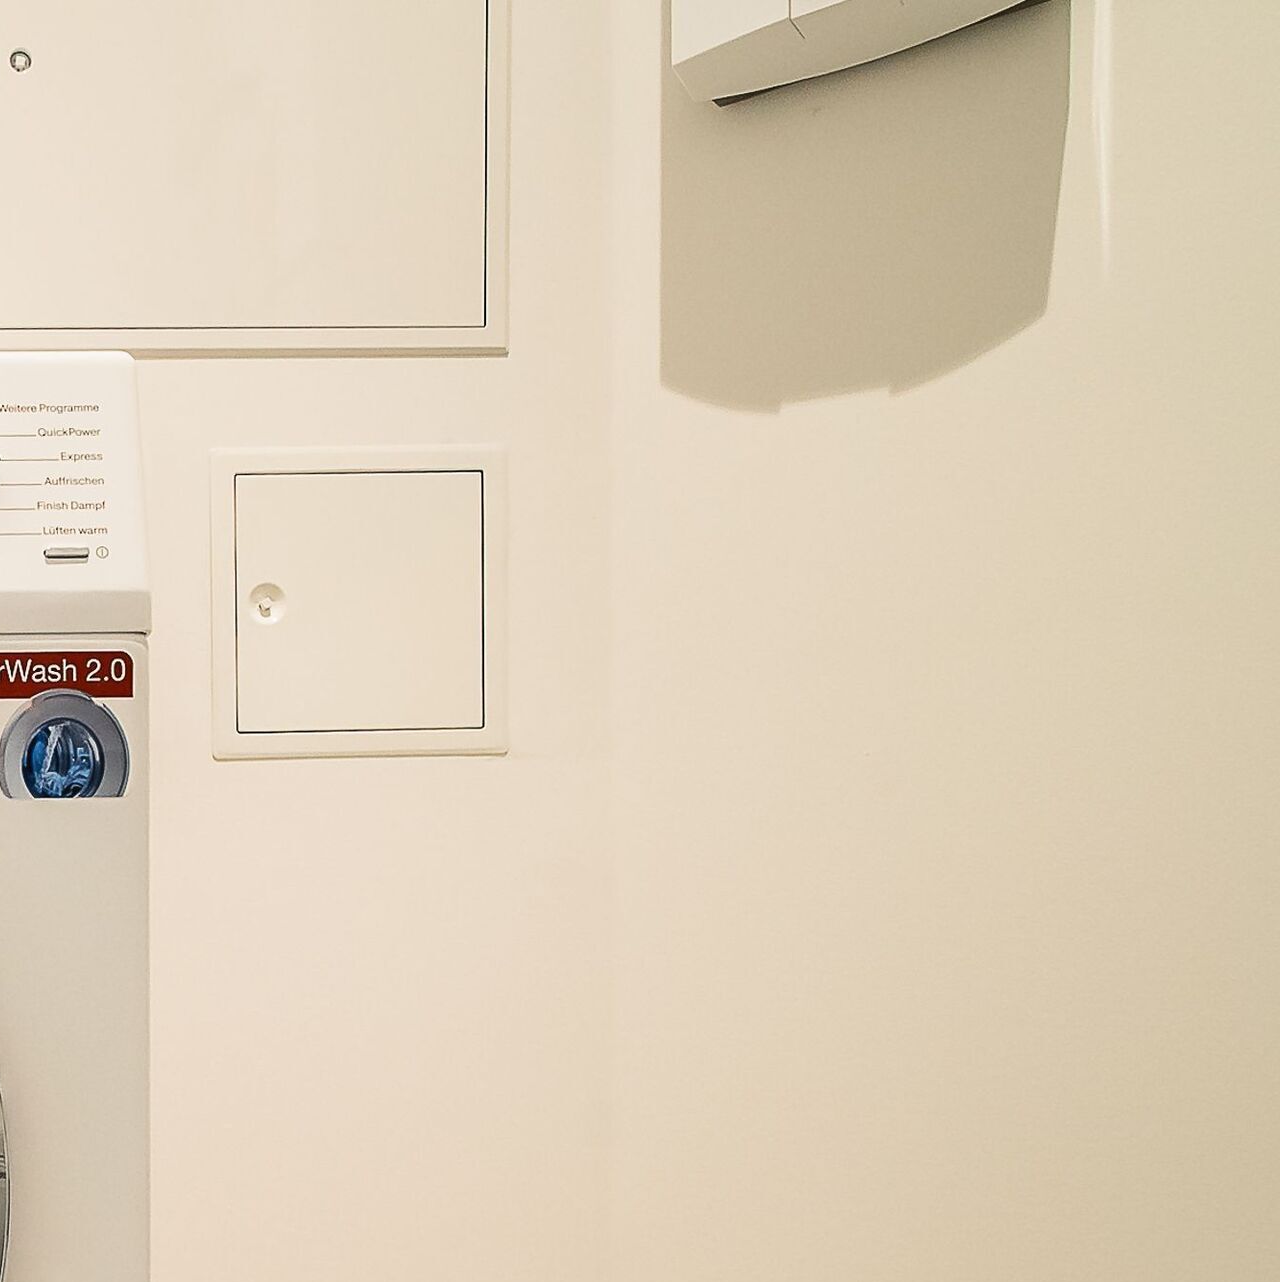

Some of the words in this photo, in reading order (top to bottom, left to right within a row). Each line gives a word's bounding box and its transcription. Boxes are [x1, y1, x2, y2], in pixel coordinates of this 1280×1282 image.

[39, 403, 100, 414] Programme
[37, 427, 101, 437] QuickPower
[60, 451, 104, 462] Express
[44, 476, 105, 486] Auffrischen
[36, 501, 69, 510] Finish
[70, 500, 106, 511] Dampf
[42, 525, 77, 535] Lüften
[78, 527, 108, 535] warm
[85, 657, 126, 683] 2.0
